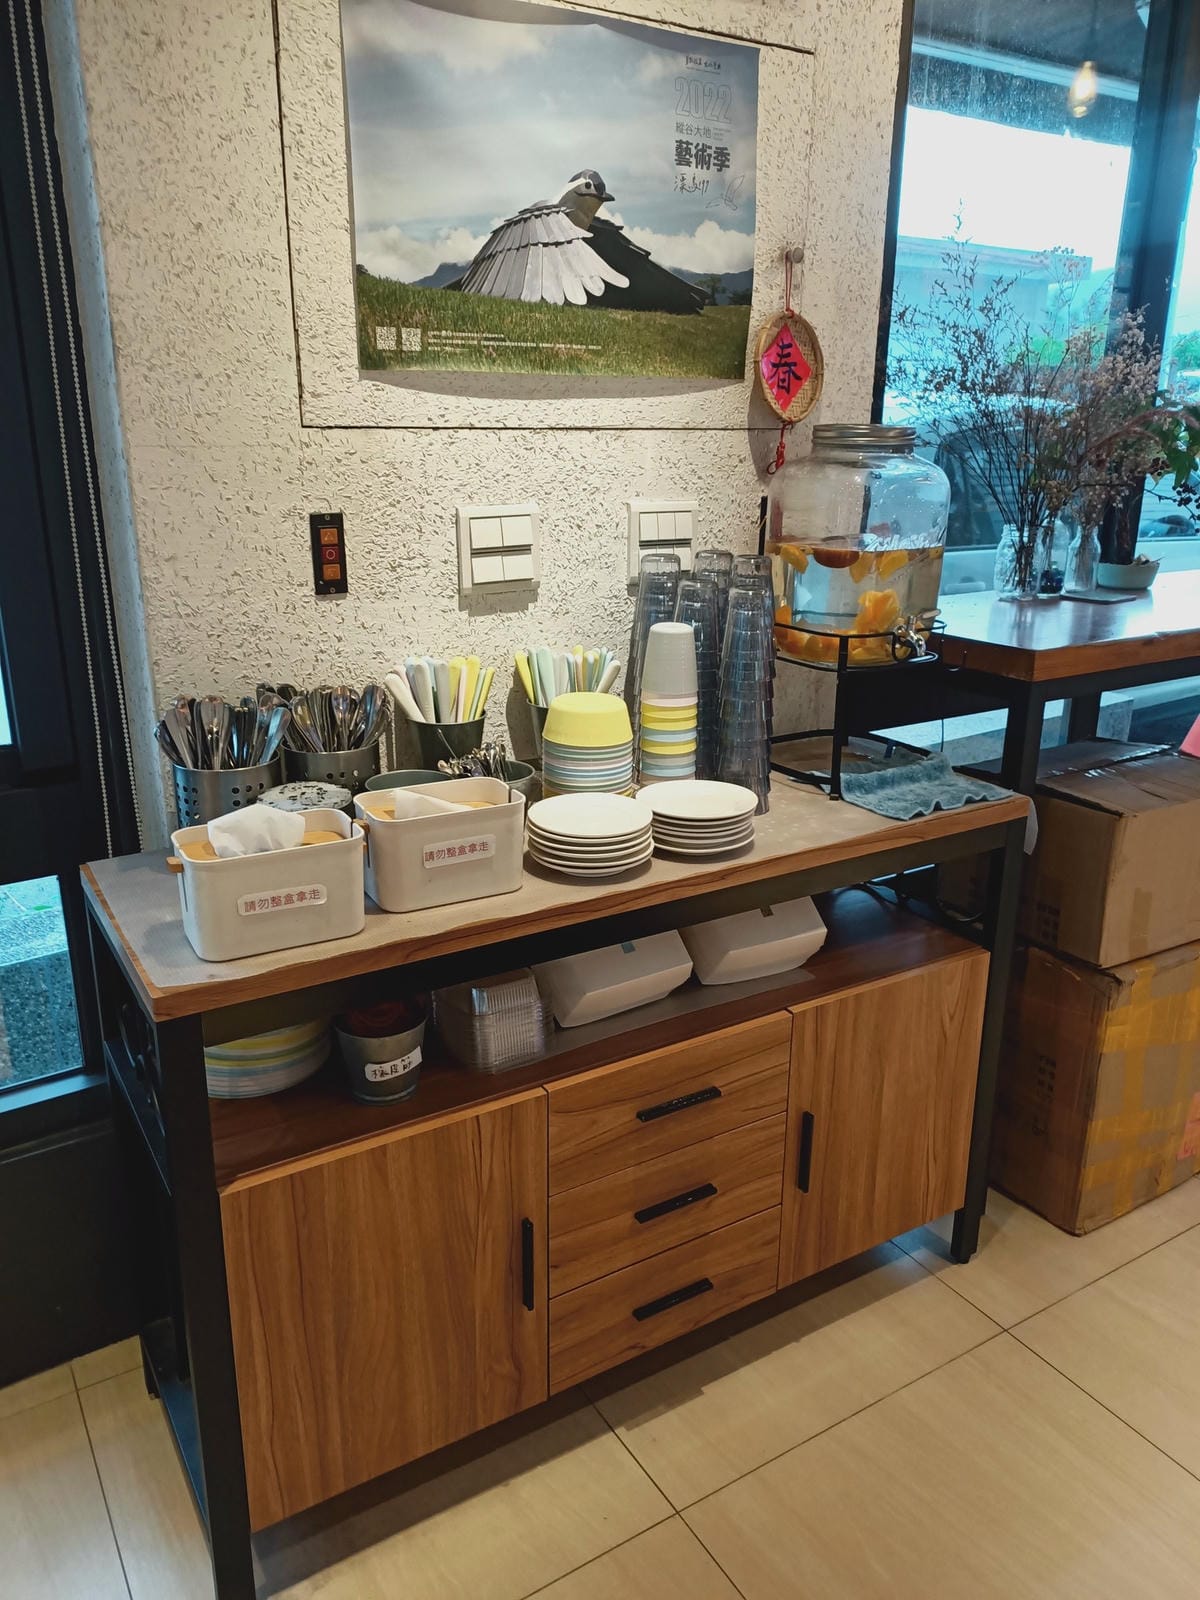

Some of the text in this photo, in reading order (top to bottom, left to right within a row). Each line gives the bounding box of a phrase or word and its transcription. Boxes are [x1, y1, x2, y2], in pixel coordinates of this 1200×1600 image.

[674, 76, 732, 124] 2022
[674, 139, 731, 172] 藝術季
[769, 338, 802, 394] 春
[424, 841, 490, 862] 請勿整盒拿走
[244, 889, 321, 913] 請勿整盒拿走
